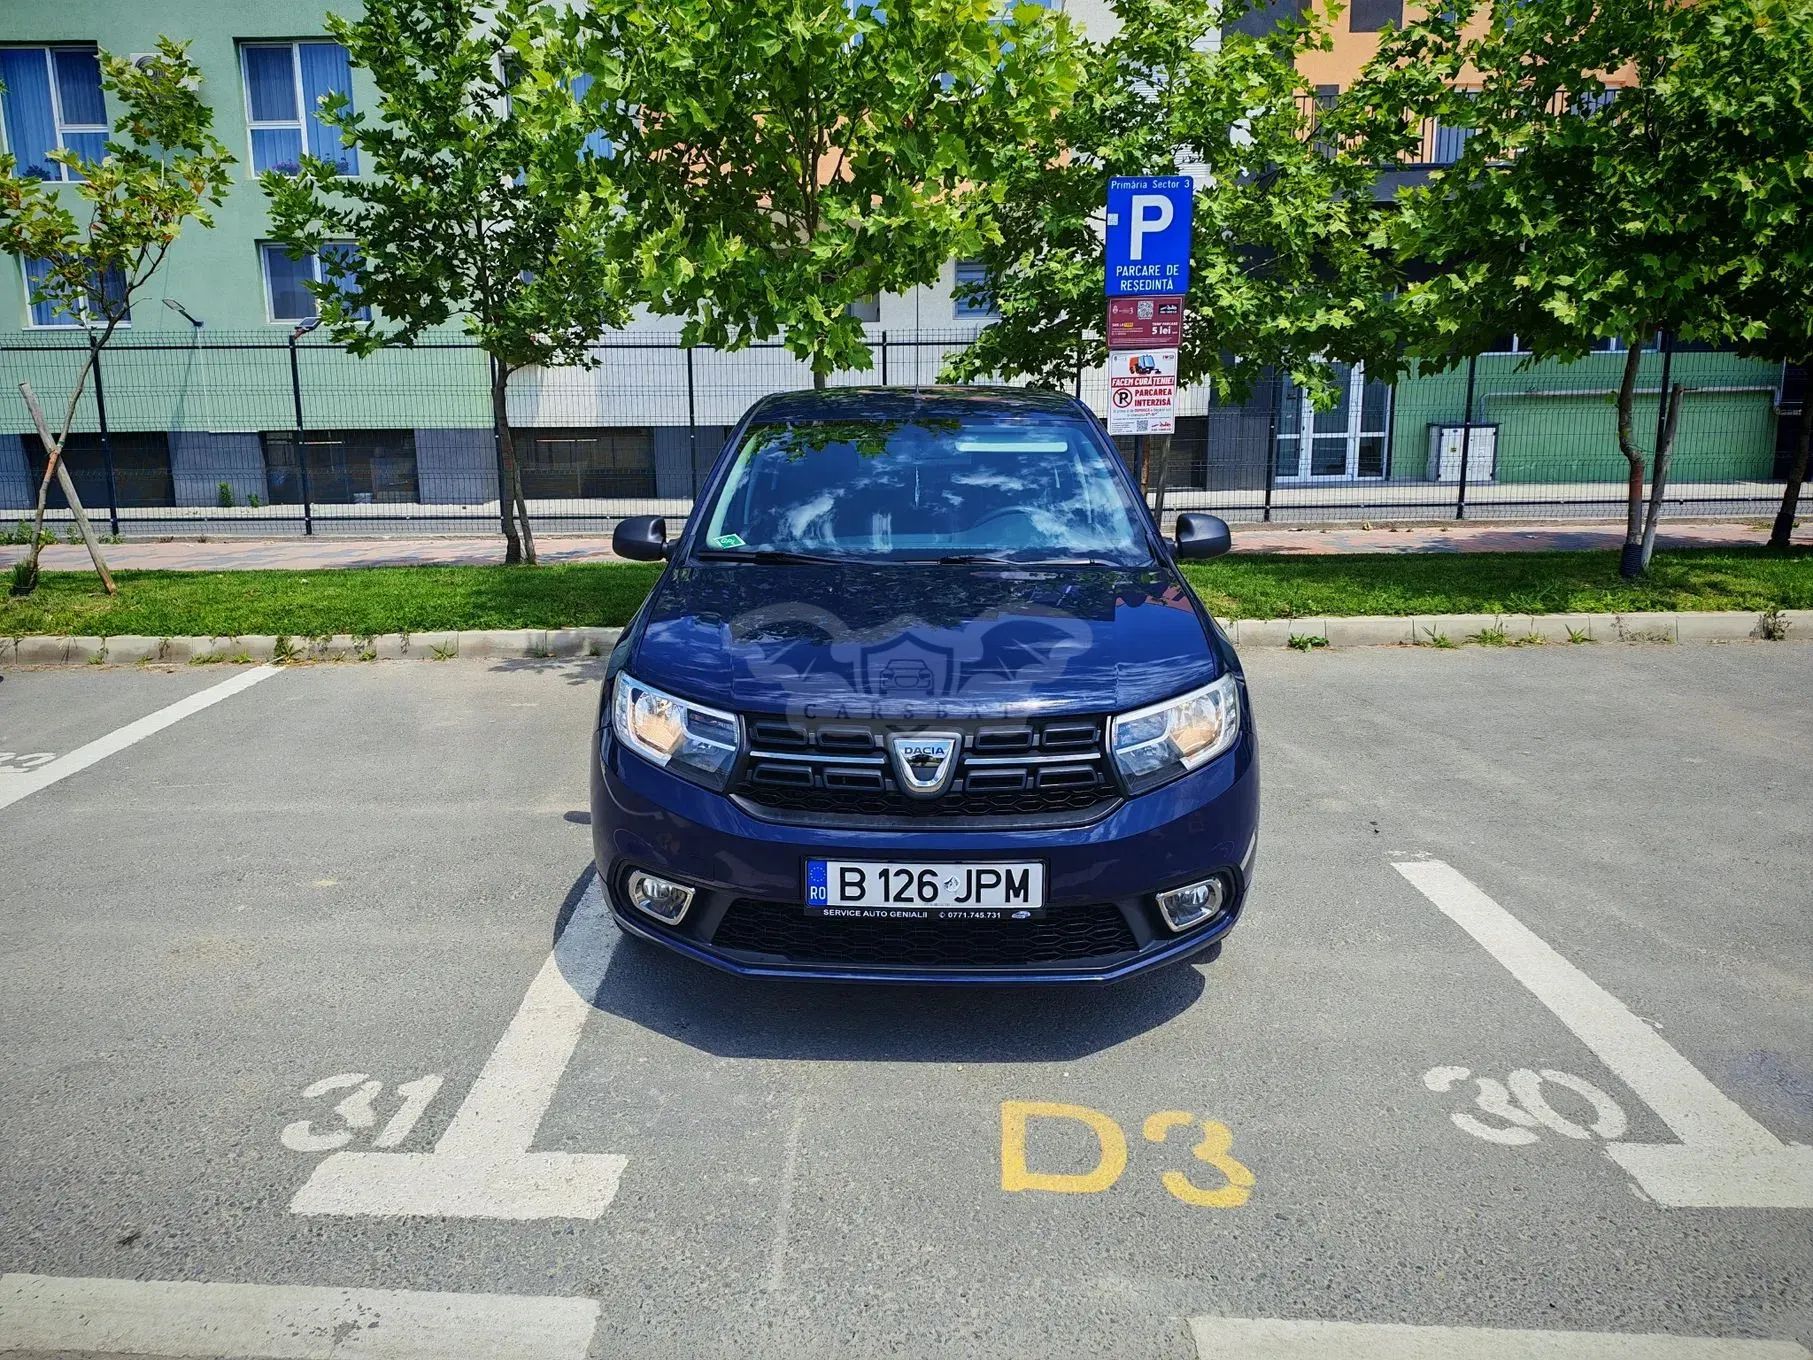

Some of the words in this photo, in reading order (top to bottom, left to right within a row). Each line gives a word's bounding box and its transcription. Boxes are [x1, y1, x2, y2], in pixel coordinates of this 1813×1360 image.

[1152, 180, 1180, 189] Sector
[1184, 179, 1190, 188] 3
[1130, 194, 1174, 260] P
[1116, 265, 1161, 277] PARCARE
[1166, 264, 1180, 276] DE
[1151, 327, 1158, 335] 5
[1159, 326, 1171, 335] lei
[1112, 378, 1134, 387] FACEM
[1134, 389, 1172, 397] PARCAREA
[904, 746, 945, 755] DACIA
[839, 867, 866, 902] B
[878, 868, 939, 903] 126
[954, 868, 1030, 904] JPM
[810, 886, 826, 900] RO
[823, 909, 862, 917] SERVICE
[862, 910, 888, 918] AUTO
[947, 911, 1001, 919] 0771.745.731
[1423, 1065, 1628, 1146] 30
[280, 1073, 444, 1151] 31
